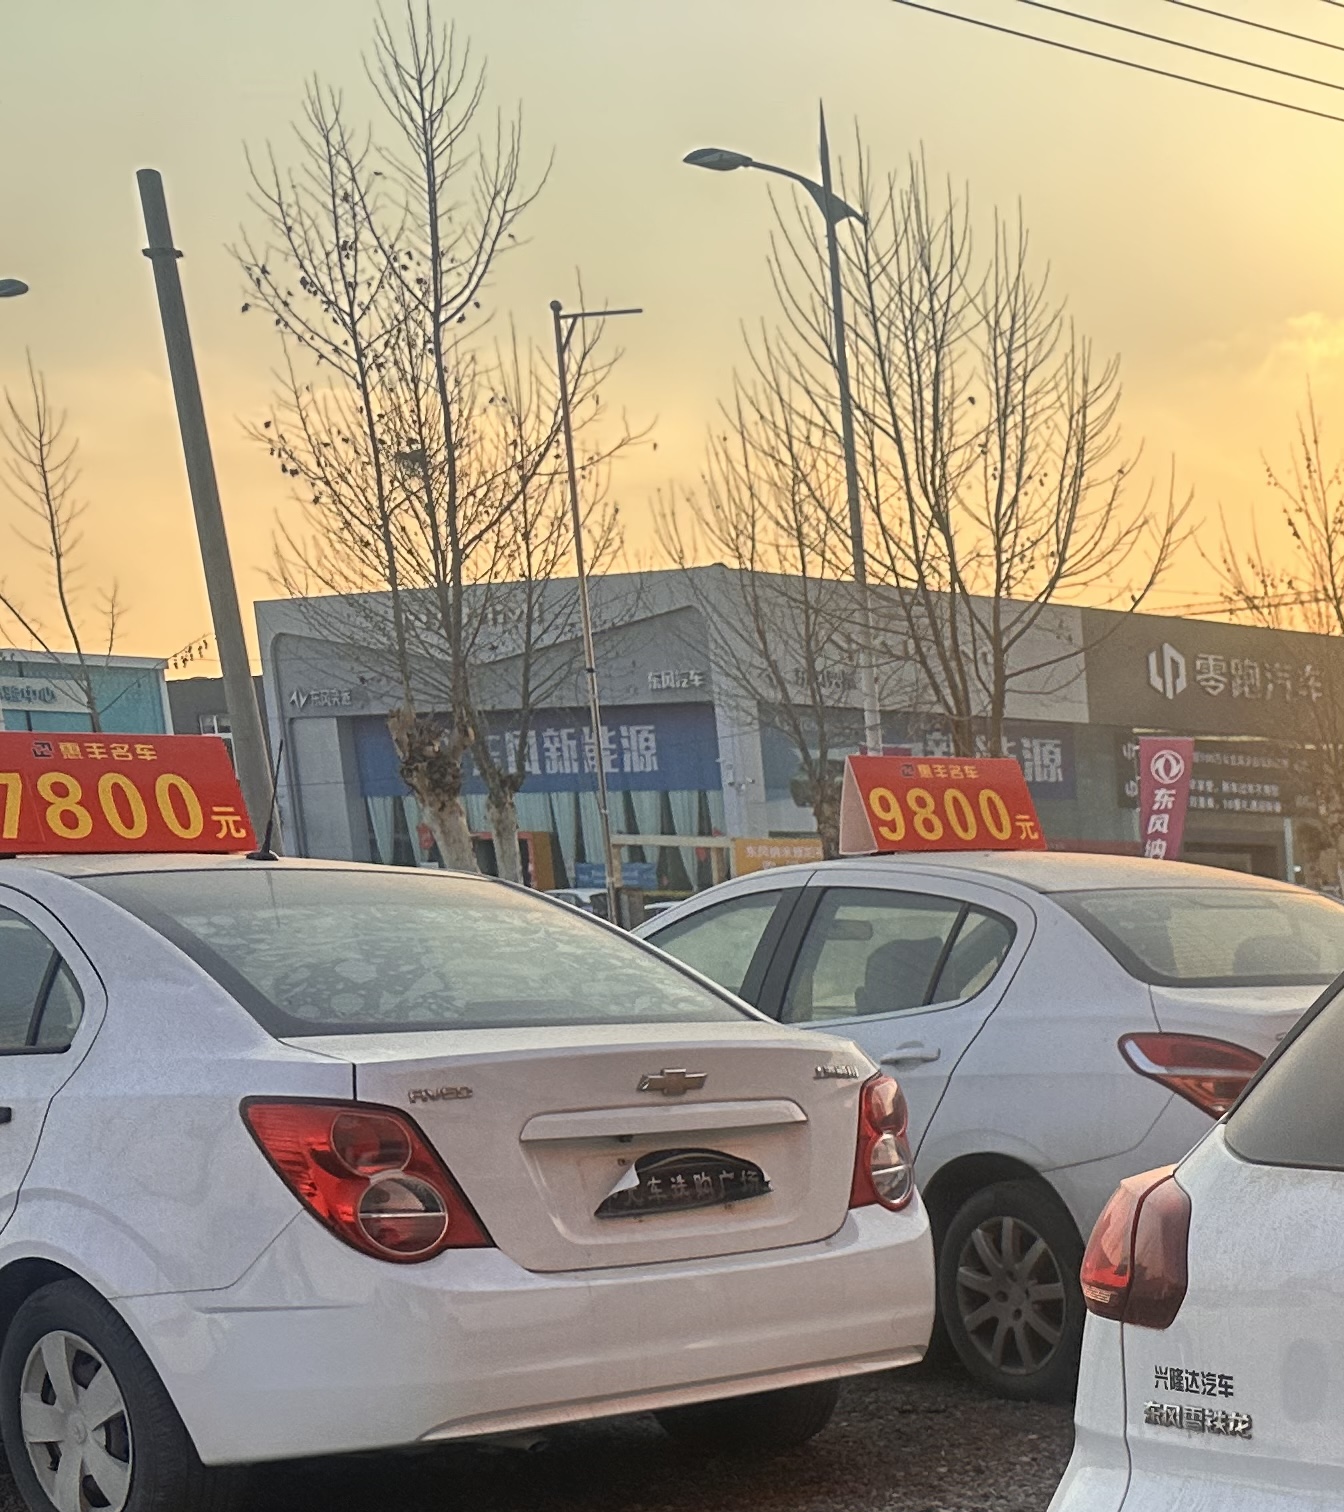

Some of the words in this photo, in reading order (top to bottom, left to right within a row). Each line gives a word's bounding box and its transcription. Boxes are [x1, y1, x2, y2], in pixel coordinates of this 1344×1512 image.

[1195, 653, 1323, 702] 零跑汽车
[58, 742, 158, 761] 惠丰名车
[1154, 1365, 1234, 1398] 兴隆达汽车
[1144, 1400, 1253, 1440] 东风雪铁龙
